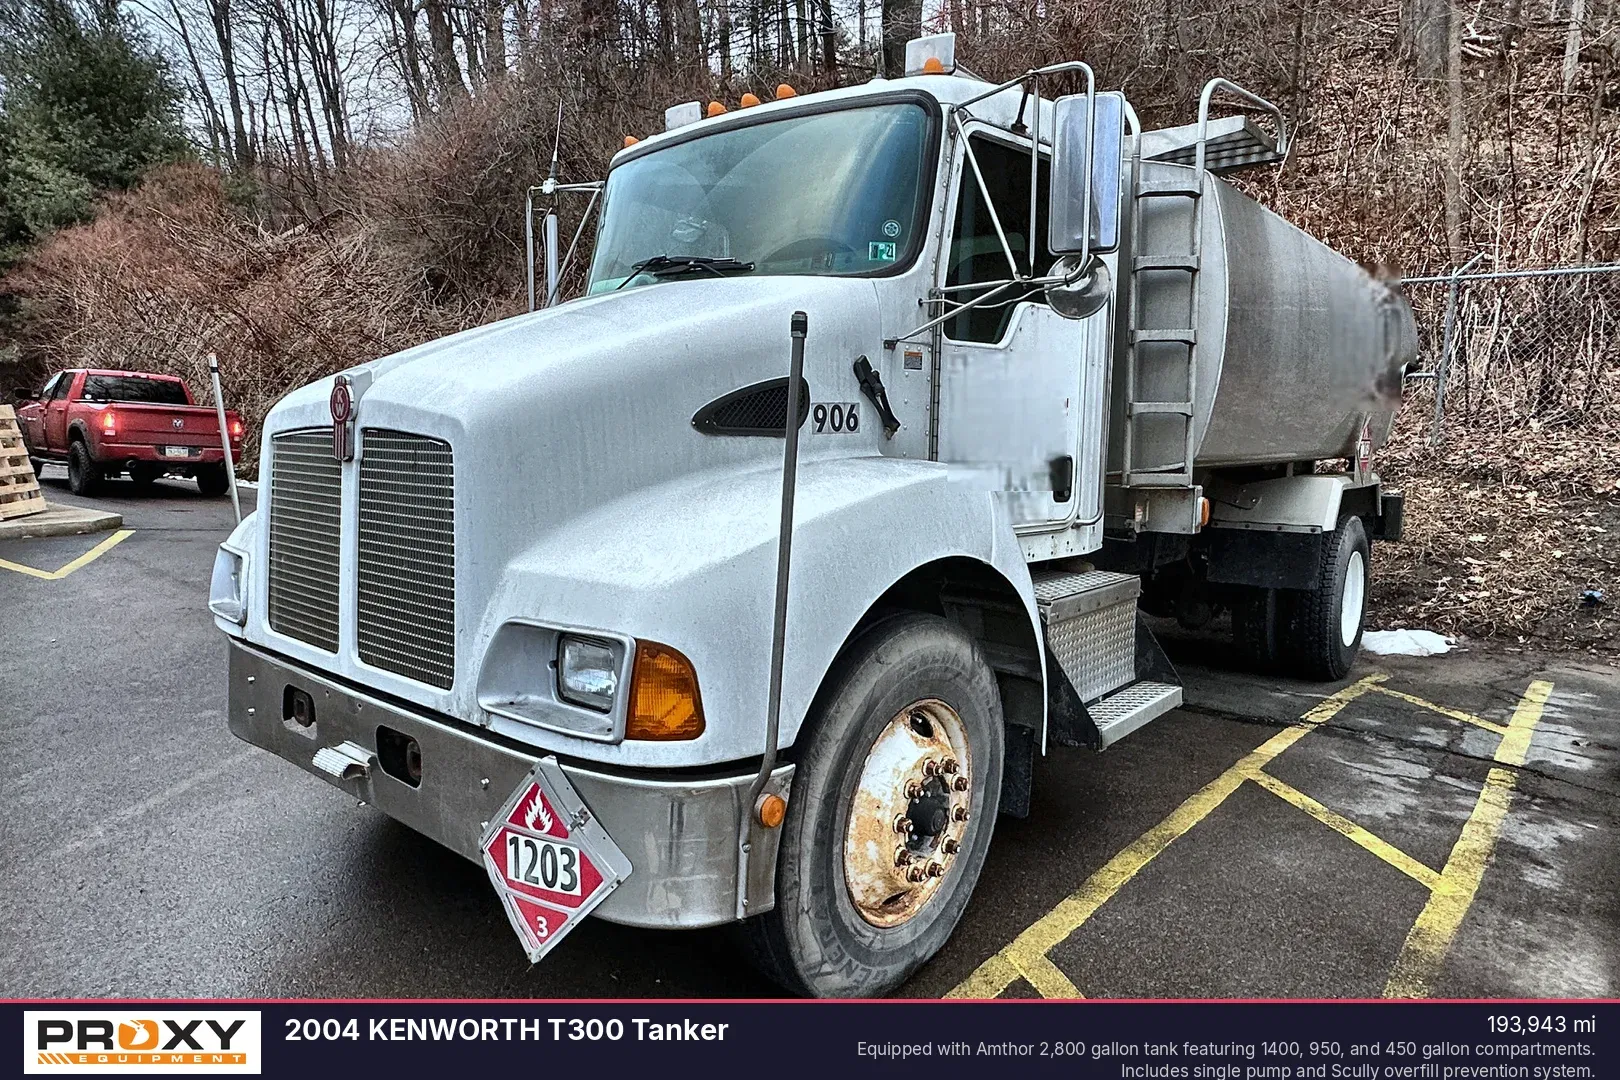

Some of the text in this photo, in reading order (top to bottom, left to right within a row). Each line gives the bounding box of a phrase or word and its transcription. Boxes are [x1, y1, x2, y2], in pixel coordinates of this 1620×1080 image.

[813, 403, 859, 433] 906
[508, 836, 578, 892] 1203
[536, 915, 549, 938] 3
